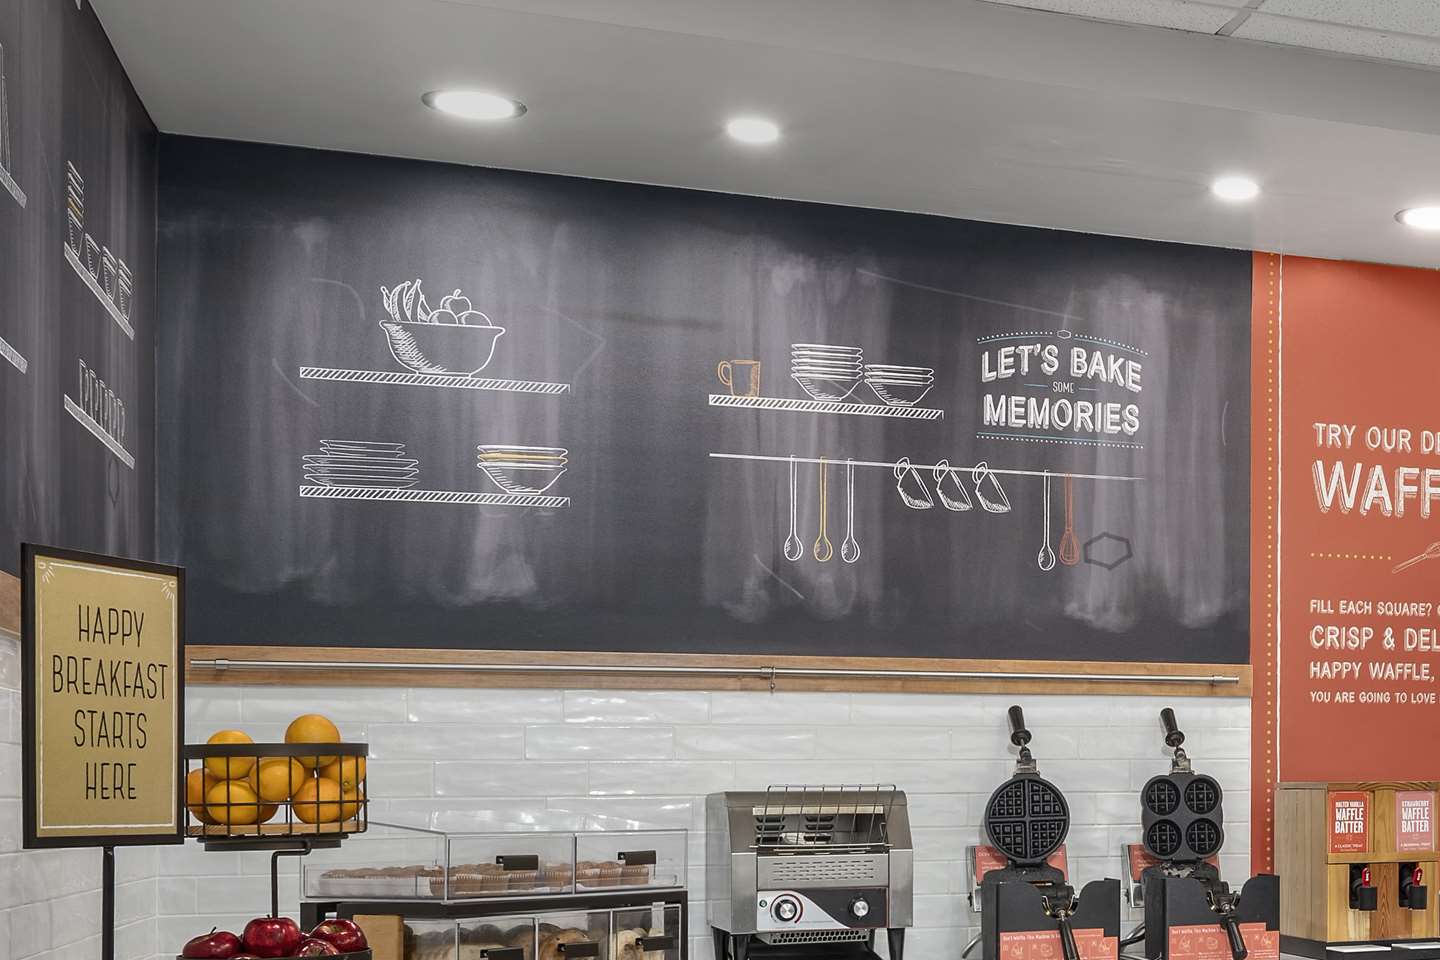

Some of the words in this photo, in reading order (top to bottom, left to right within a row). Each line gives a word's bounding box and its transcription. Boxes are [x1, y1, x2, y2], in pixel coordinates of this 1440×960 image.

[981, 343, 1059, 383] LET'S
[1070, 346, 1142, 393] BAKE
[1052, 381, 1075, 394] SOME
[983, 394, 1140, 436] MEMORIES
[1313, 423, 1357, 448] TRY
[1366, 426, 1412, 452] OUR
[1310, 599, 1334, 614] FILL
[1339, 600, 1372, 615] EACH
[1377, 601, 1432, 617] SQUARE?
[78, 604, 145, 648] HAPPY
[1310, 625, 1374, 650] CRISP
[1383, 627, 1395, 650] &
[52, 655, 168, 700] BREAKFAST
[1309, 662, 1362, 680] HAPPY
[1369, 662, 1435, 682] WAFFLE,
[1310, 691, 1331, 703] YOU
[1335, 691, 1355, 704] ARE
[1359, 692, 1391, 704] GOING
[1395, 692, 1407, 704] TO
[1411, 693, 1436, 704] LOVE
[74, 709, 147, 749] STARTS
[85, 762, 137, 800] HERE
[1335, 808, 1364, 820] WAFFLE
[1402, 807, 1429, 820] WAFFLE
[1335, 820, 1364, 833] BATTER
[1402, 820, 1429, 832] BATTER
